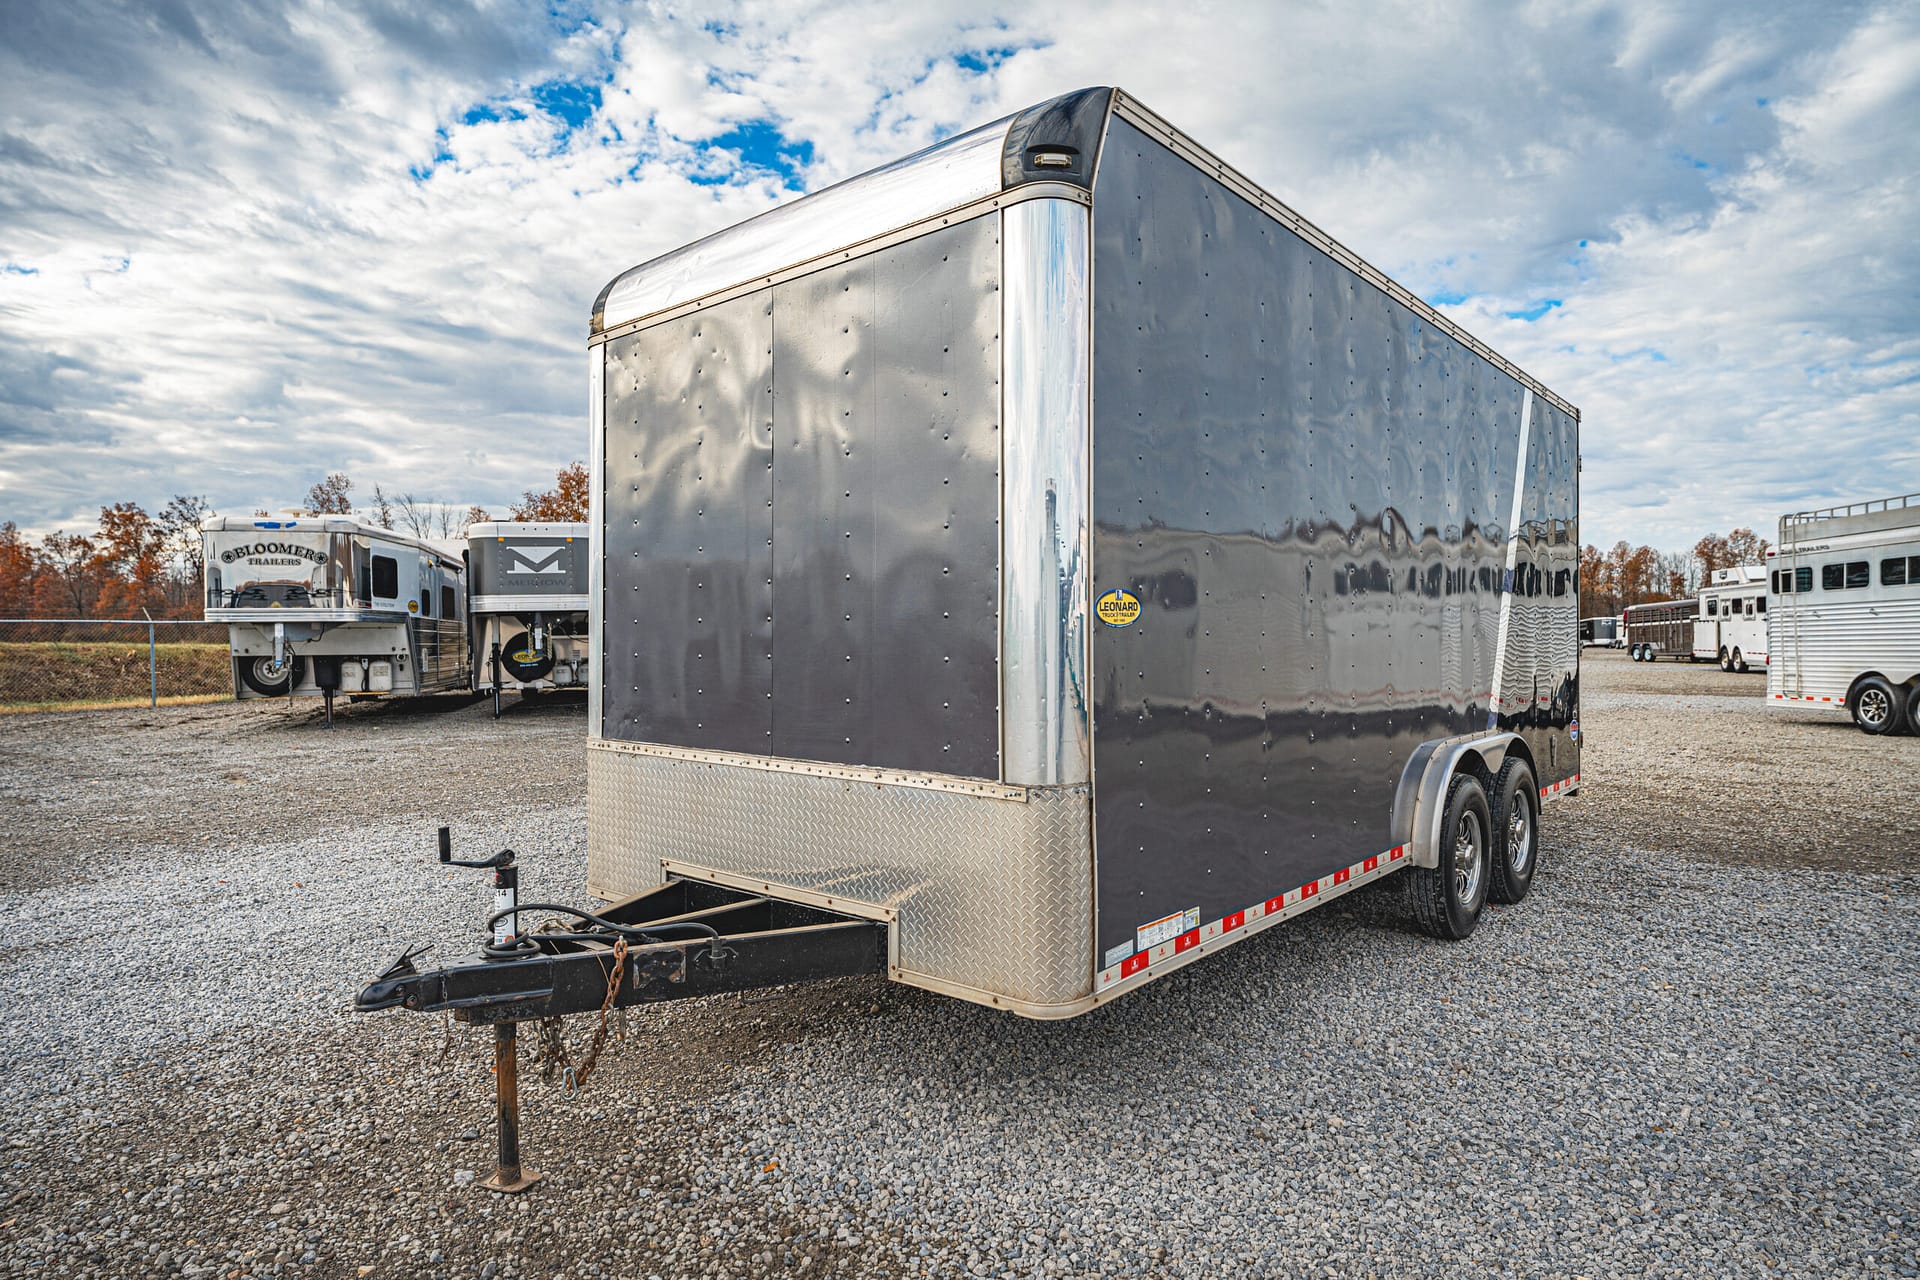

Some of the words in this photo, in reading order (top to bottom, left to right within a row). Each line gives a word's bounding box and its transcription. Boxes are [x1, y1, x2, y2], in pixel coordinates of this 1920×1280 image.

[233, 542, 316, 561] BLOOMER
[247, 557, 302, 566] TRAILERS
[1099, 601, 1138, 611] LEONARD
